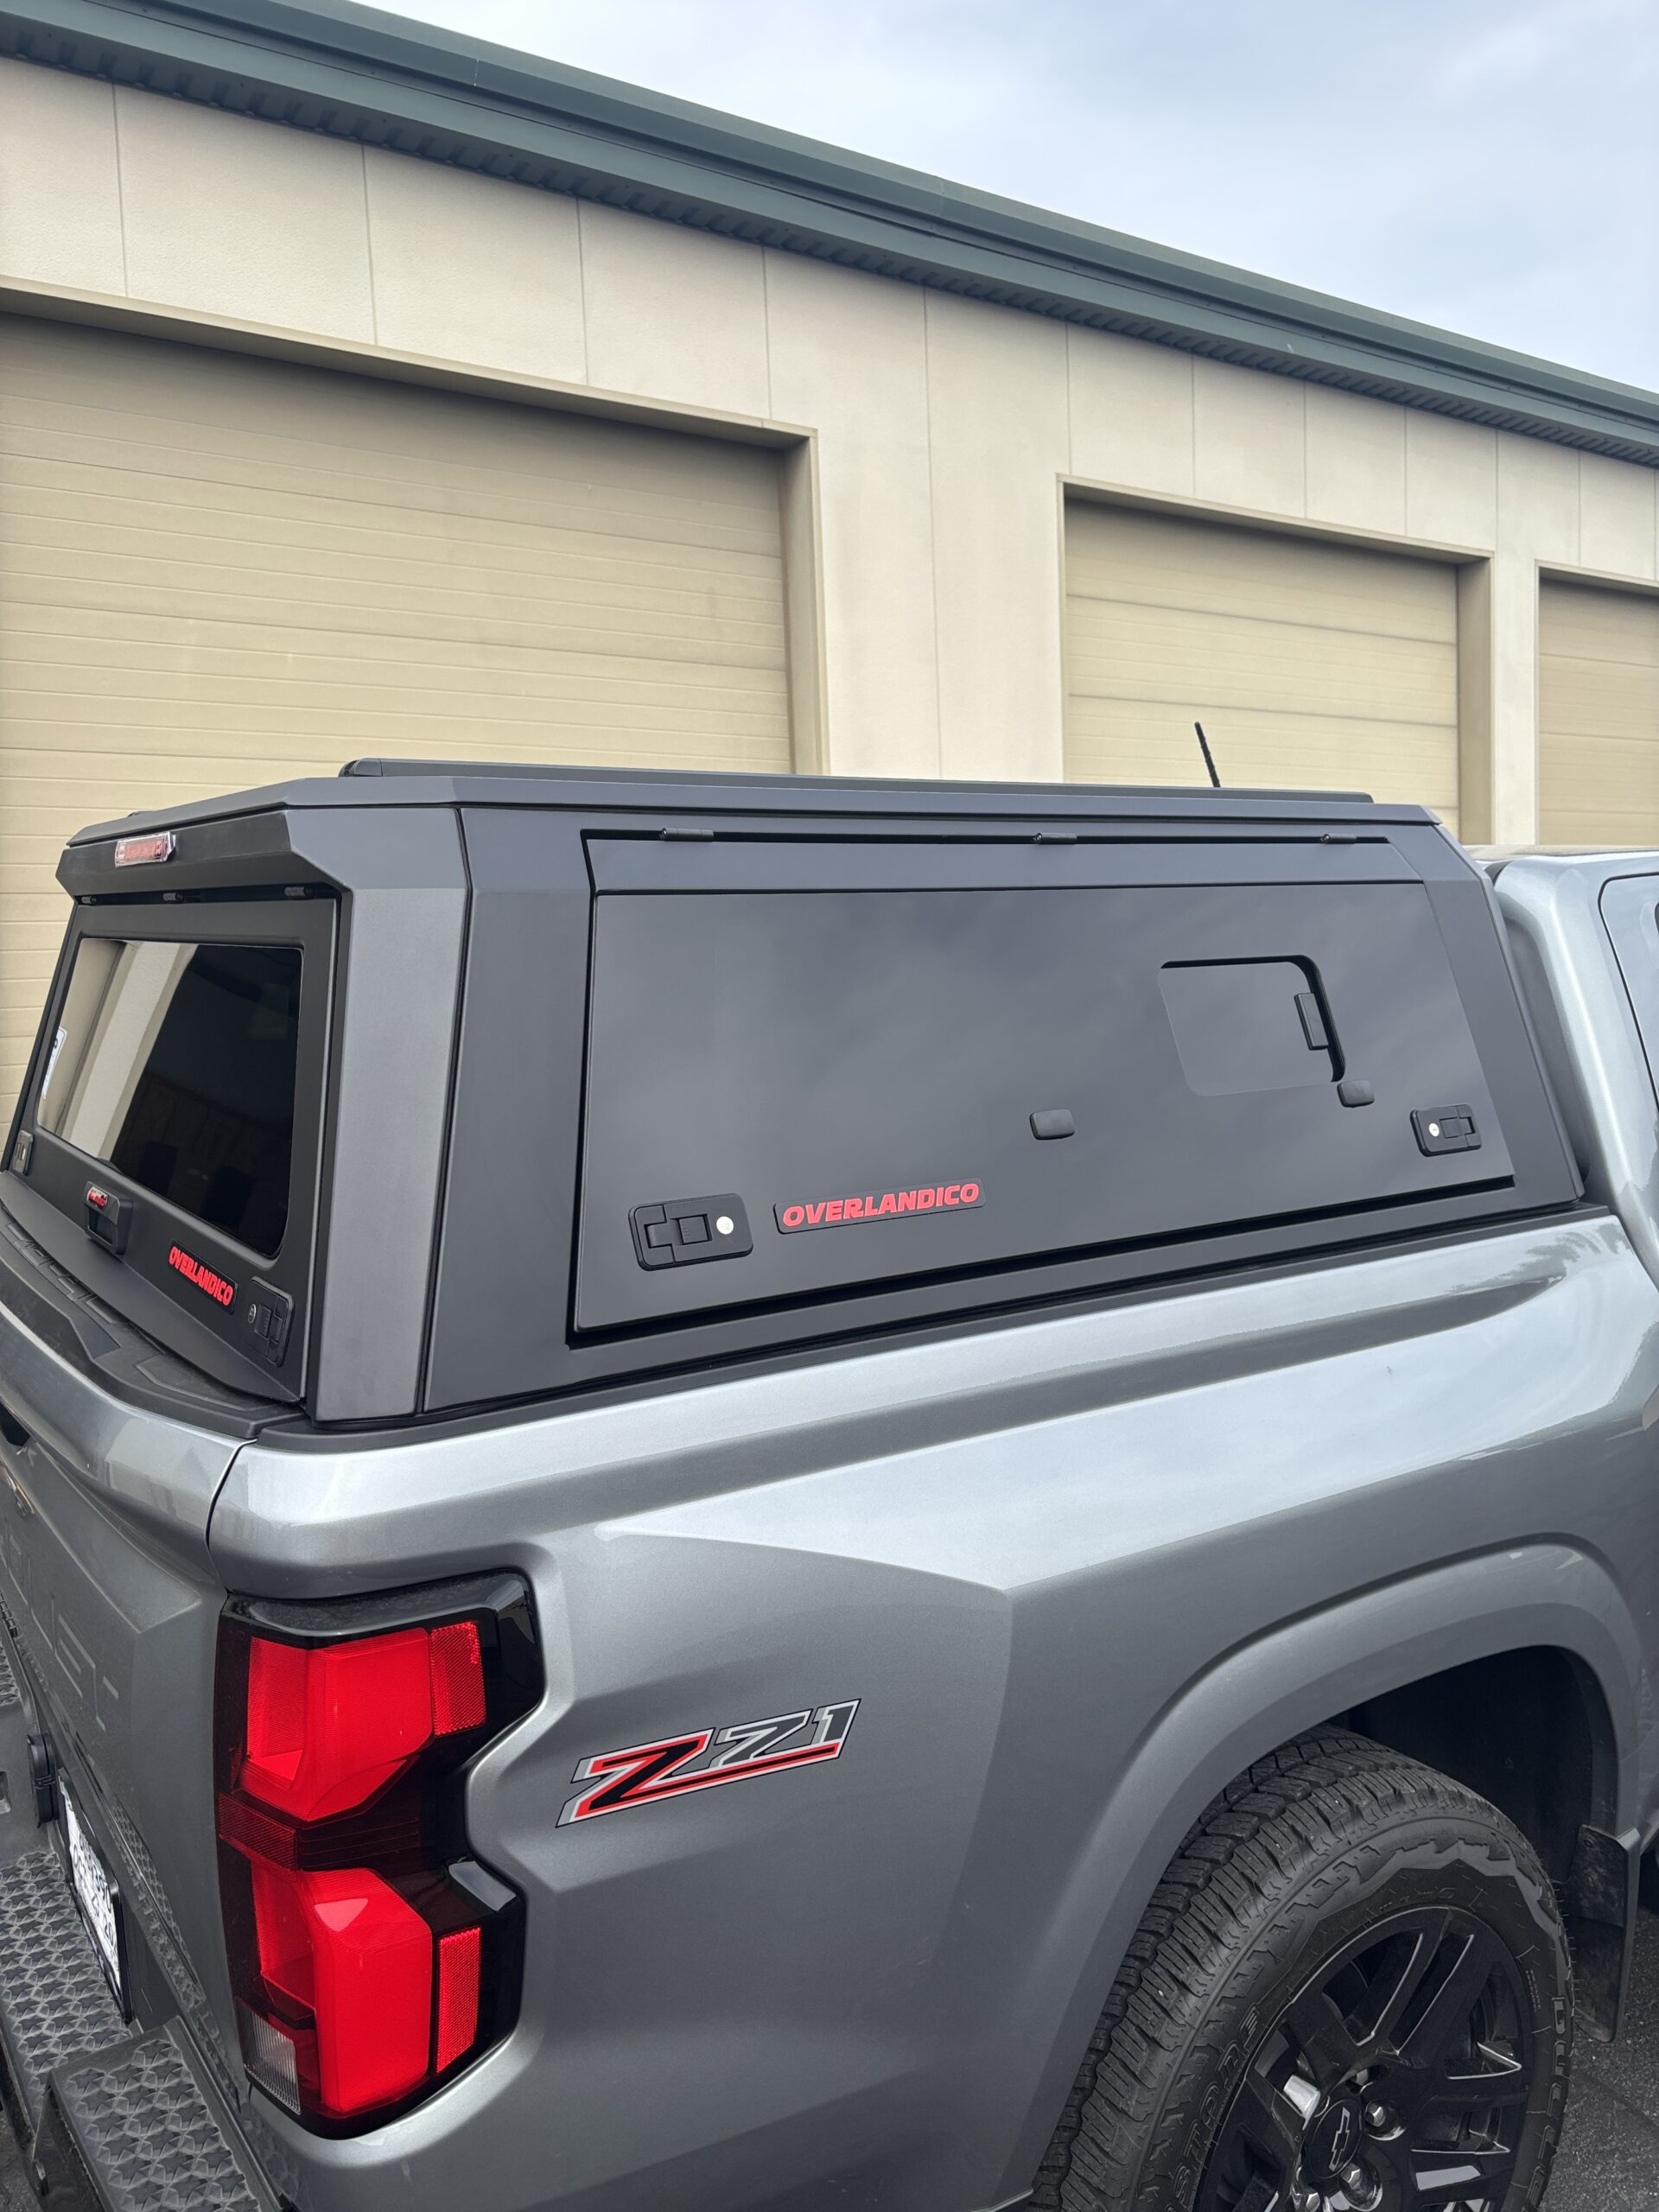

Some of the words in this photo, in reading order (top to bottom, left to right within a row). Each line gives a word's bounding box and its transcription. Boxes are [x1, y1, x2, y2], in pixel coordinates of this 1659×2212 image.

[781, 1182, 981, 1228] OVERLANDICO
[168, 1245, 234, 1306] OVERLANDICO
[555, 1697, 862, 1828] Z71
